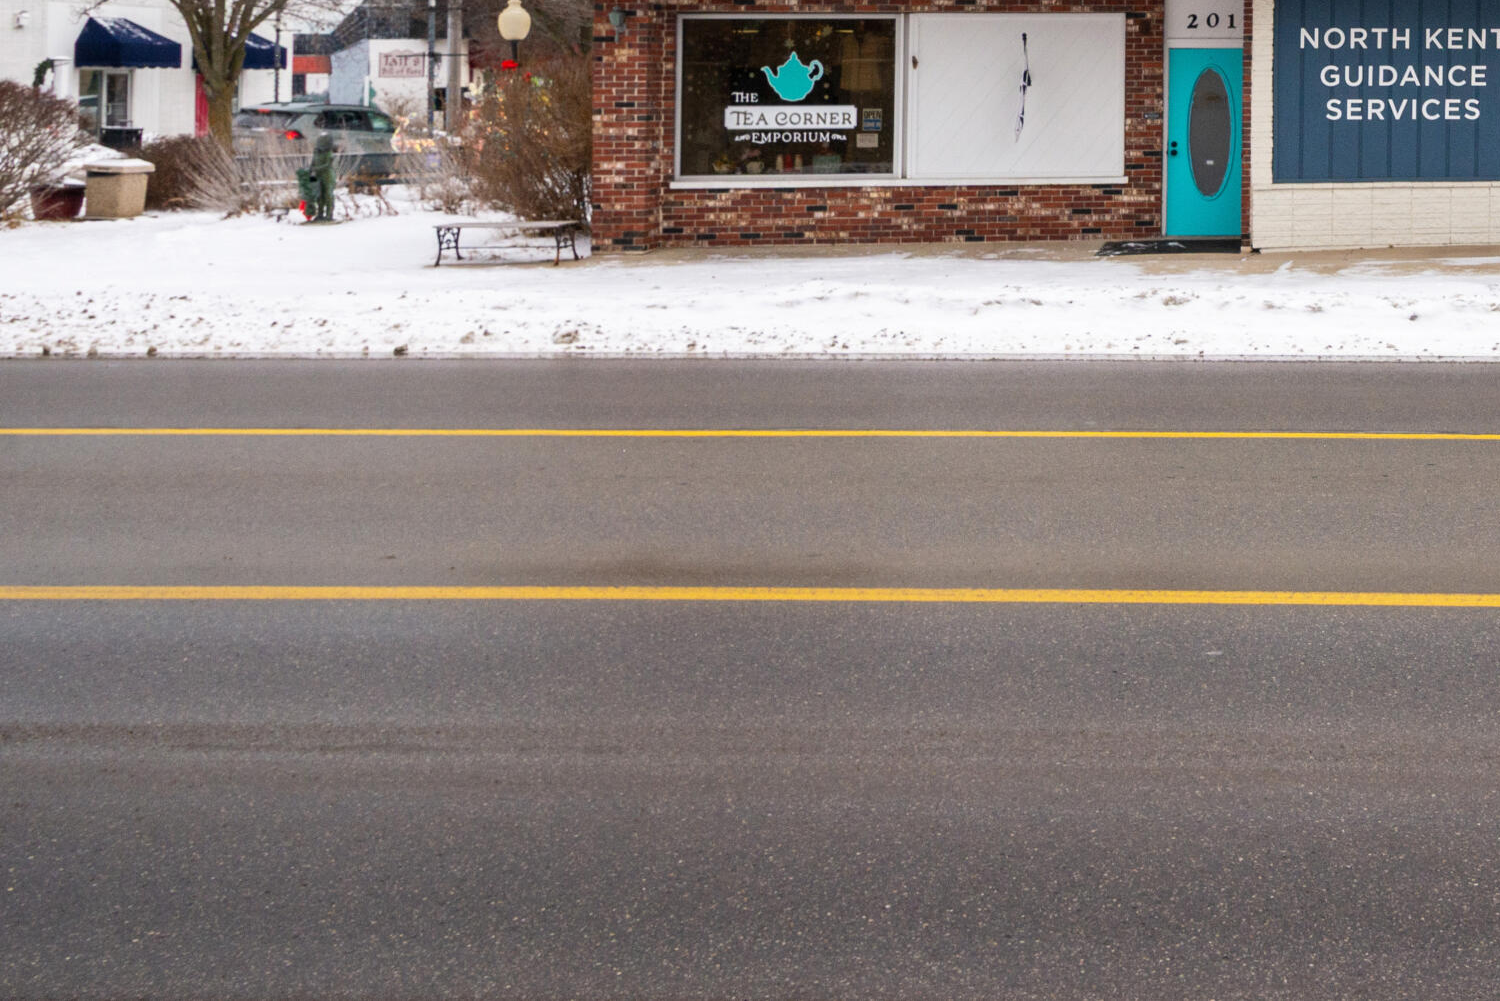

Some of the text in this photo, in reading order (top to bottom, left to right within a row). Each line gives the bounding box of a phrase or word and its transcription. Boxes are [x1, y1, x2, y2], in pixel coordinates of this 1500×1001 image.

[1186, 12, 1237, 29] 201
[1300, 27, 1411, 50] NORTH
[1319, 64, 1487, 88] GUIDANCE
[731, 91, 759, 103] THE
[863, 110, 881, 119] OPEN
[1325, 98, 1481, 121] SERVICES
[729, 110, 852, 126] TEA CORNER
[751, 132, 830, 144] EMPORIUM
